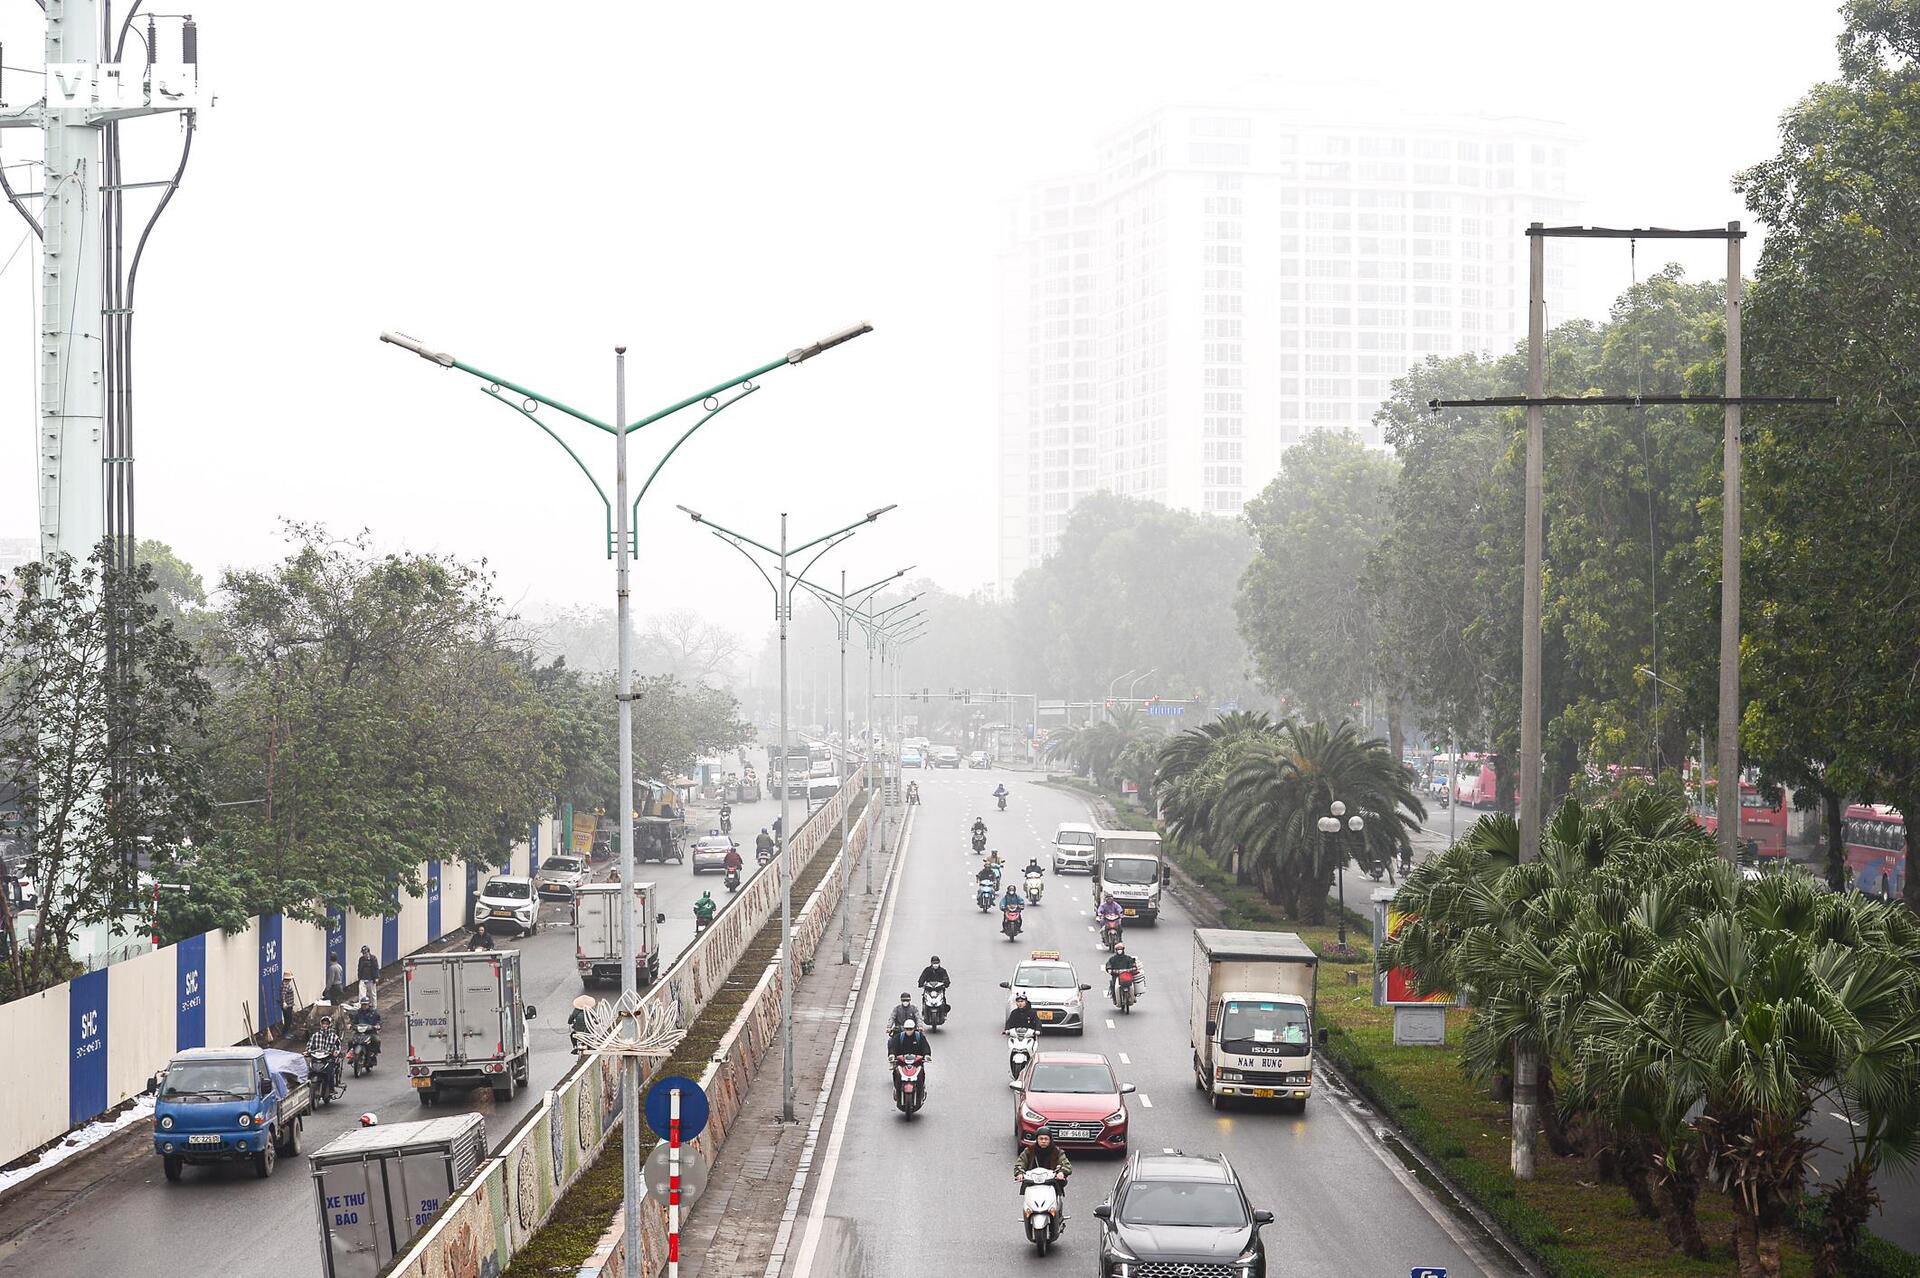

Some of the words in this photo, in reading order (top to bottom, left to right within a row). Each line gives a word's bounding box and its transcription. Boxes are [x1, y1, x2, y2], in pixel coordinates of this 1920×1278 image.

[81, 1009, 98, 1040] SHC
[1251, 1046, 1280, 1054] ISUZU
[1237, 1057, 1255, 1068] NAM
[1261, 1058, 1283, 1069] HUNG
[326, 1196, 341, 1209] XE
[343, 1192, 365, 1207] THƯ
[420, 1198, 439, 1212] 29H
[336, 1209, 358, 1225] BẢO
